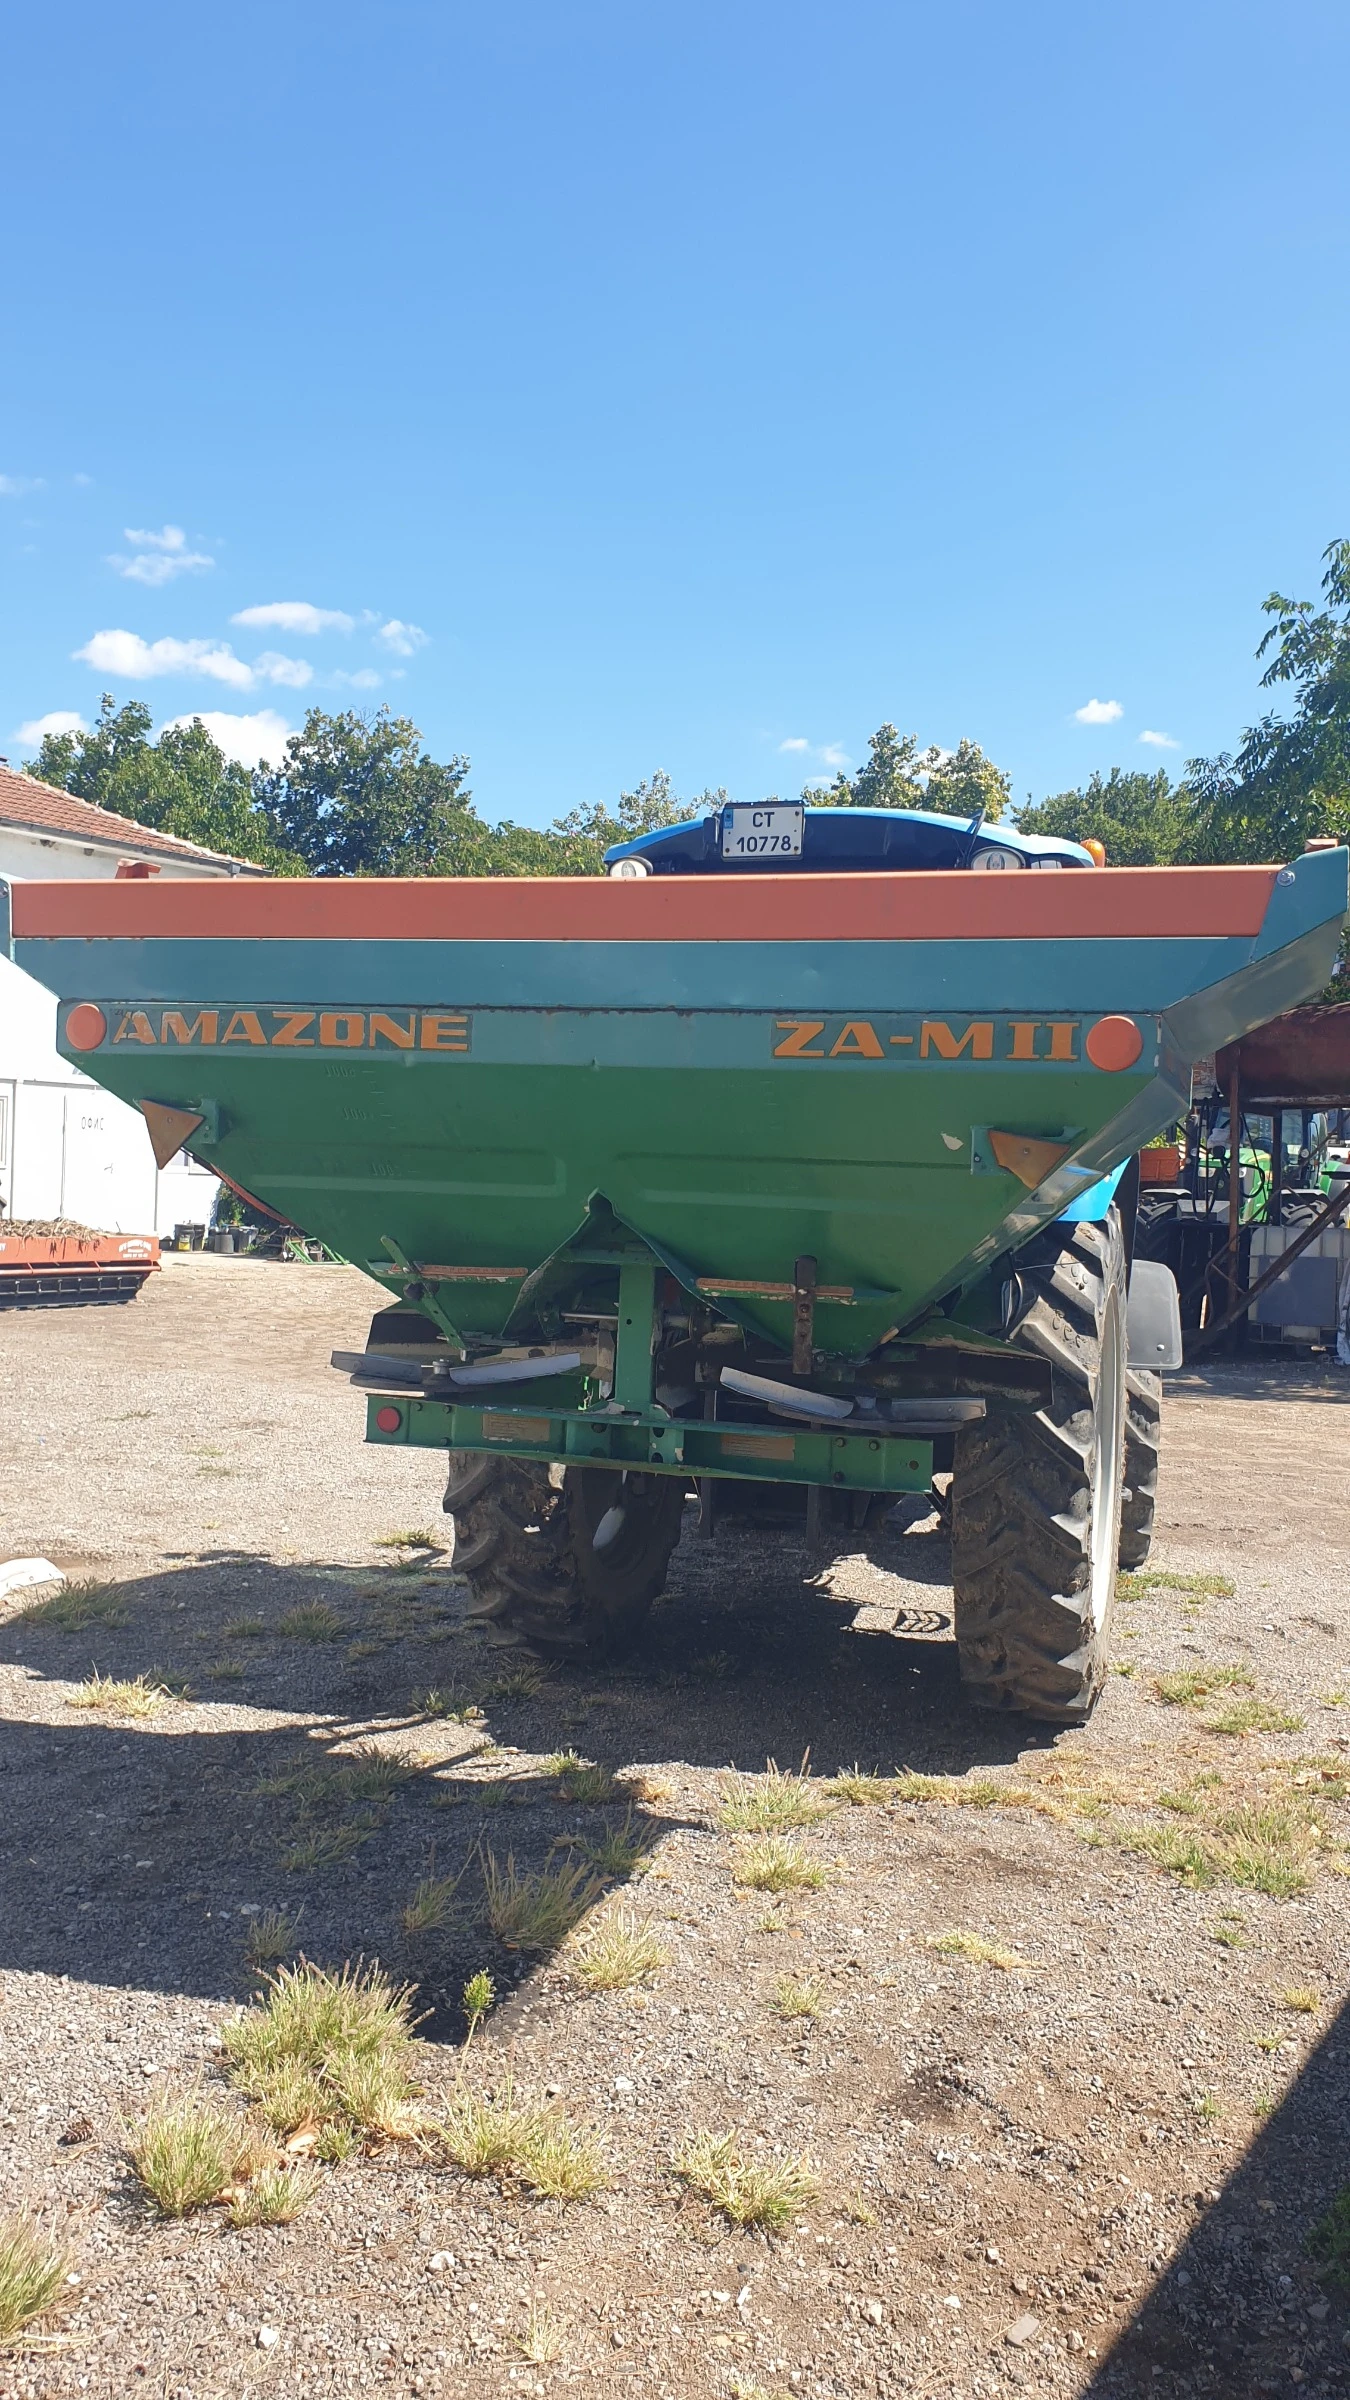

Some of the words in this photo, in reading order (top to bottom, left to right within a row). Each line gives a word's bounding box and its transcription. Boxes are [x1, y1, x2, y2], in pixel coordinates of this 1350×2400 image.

[752, 811, 775, 828] CT
[736, 835, 792, 853] 10778
[111, 1010, 468, 1050] AMAZONE
